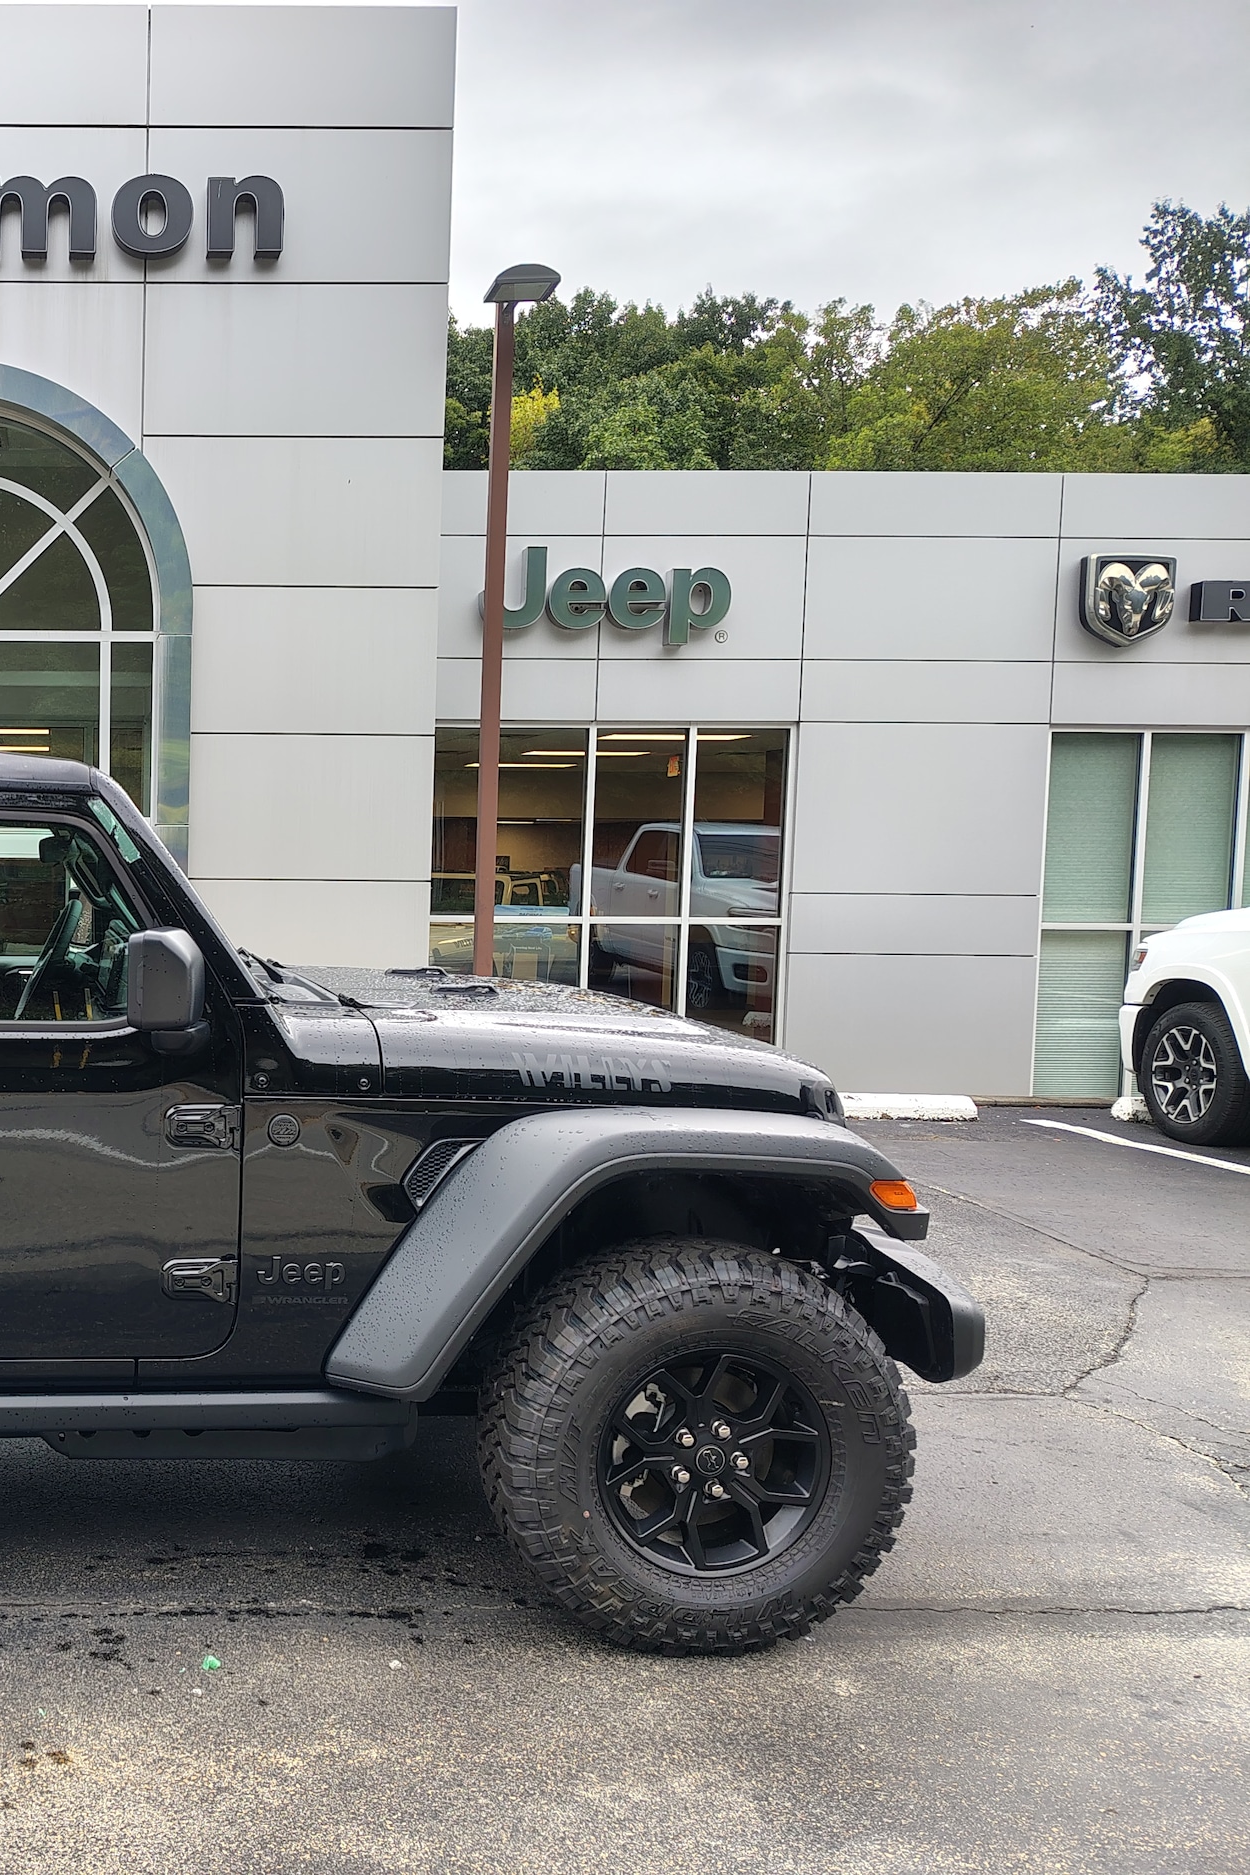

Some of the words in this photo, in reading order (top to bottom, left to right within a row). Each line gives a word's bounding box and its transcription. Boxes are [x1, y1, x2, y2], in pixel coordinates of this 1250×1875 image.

[479, 546, 731, 647] Jeep
[511, 1051, 671, 1093] WILLYS
[256, 1255, 346, 1290] Jeep
[267, 1296, 349, 1305] WRANGLER
